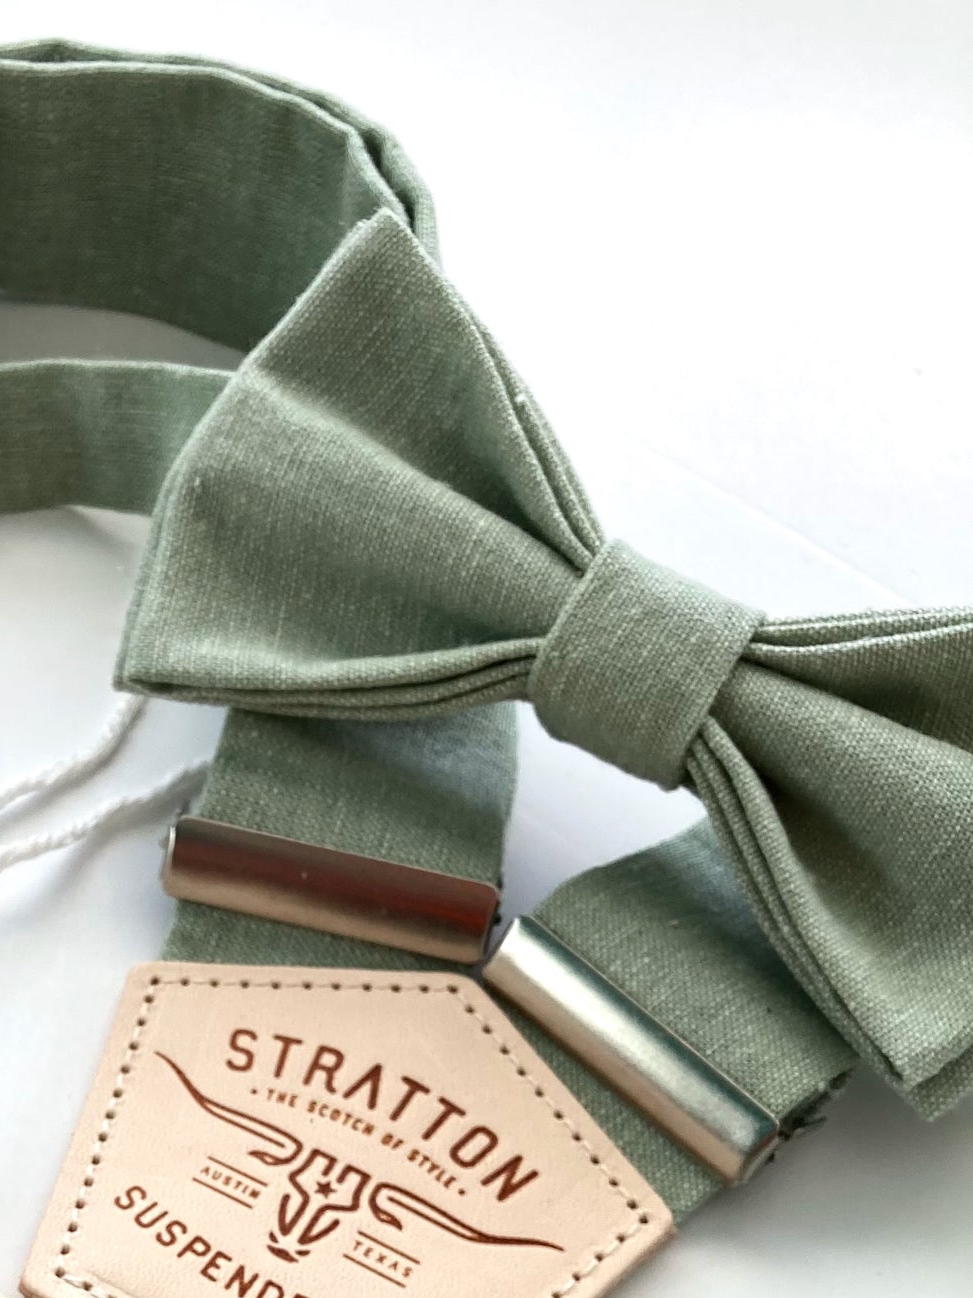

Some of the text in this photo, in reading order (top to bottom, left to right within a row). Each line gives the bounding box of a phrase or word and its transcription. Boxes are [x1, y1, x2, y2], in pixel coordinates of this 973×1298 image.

[225, 1028, 539, 1202] STRATTON
[267, 1088, 457, 1189] THE SCOTCH OF STYLE
[200, 1165, 262, 1199] AUSTIN
[353, 1240, 414, 1278] TEXAS
